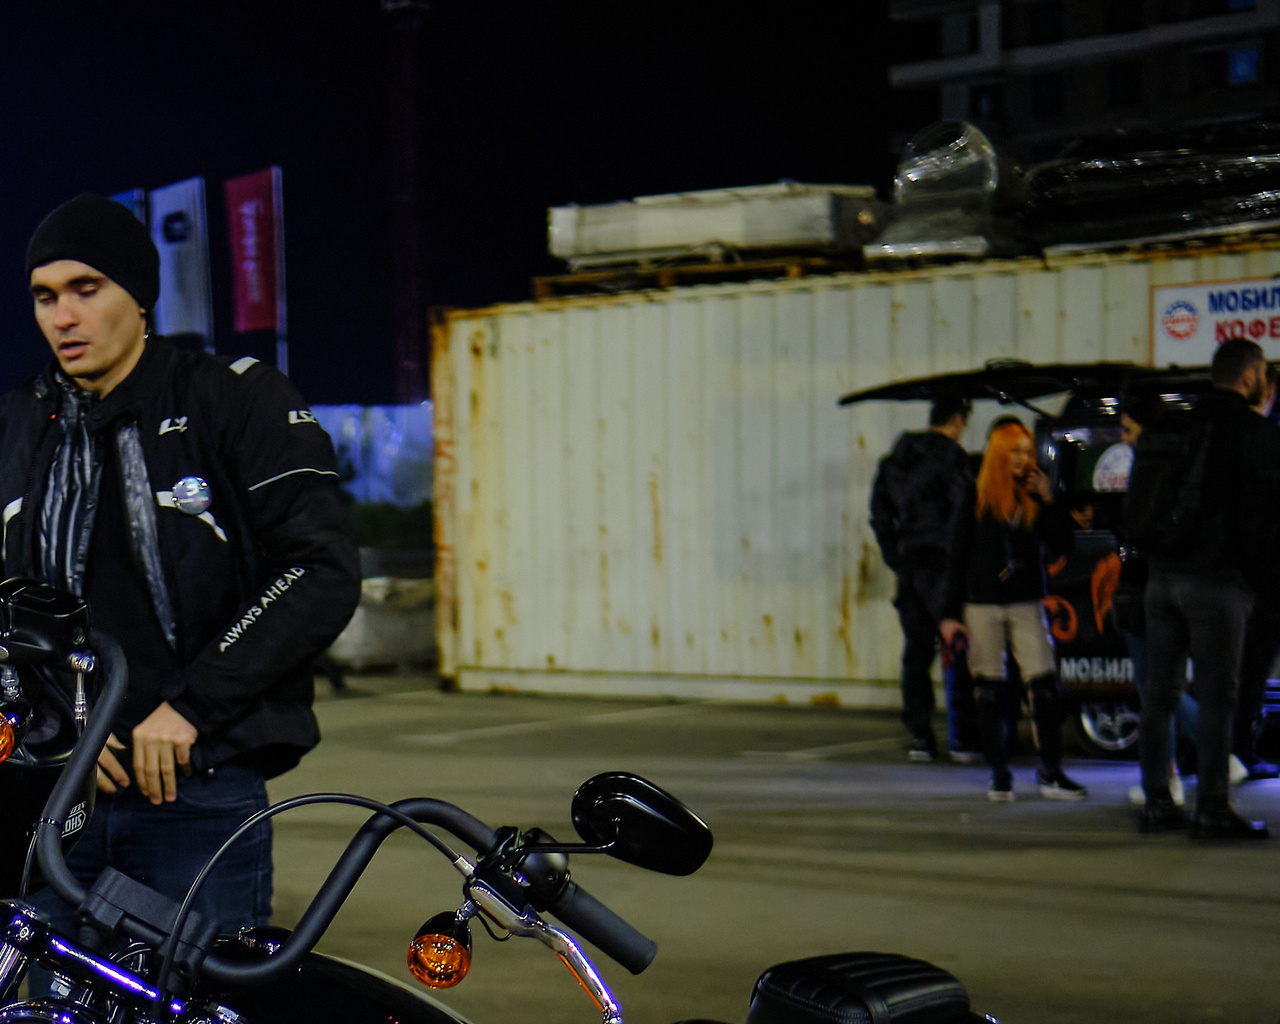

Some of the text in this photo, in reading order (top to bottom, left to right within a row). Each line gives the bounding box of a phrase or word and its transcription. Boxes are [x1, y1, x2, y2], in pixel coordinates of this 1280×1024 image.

[1215, 316, 1280, 342] КОФЕ
[219, 566, 305, 653] ALWAYS AHEAD
